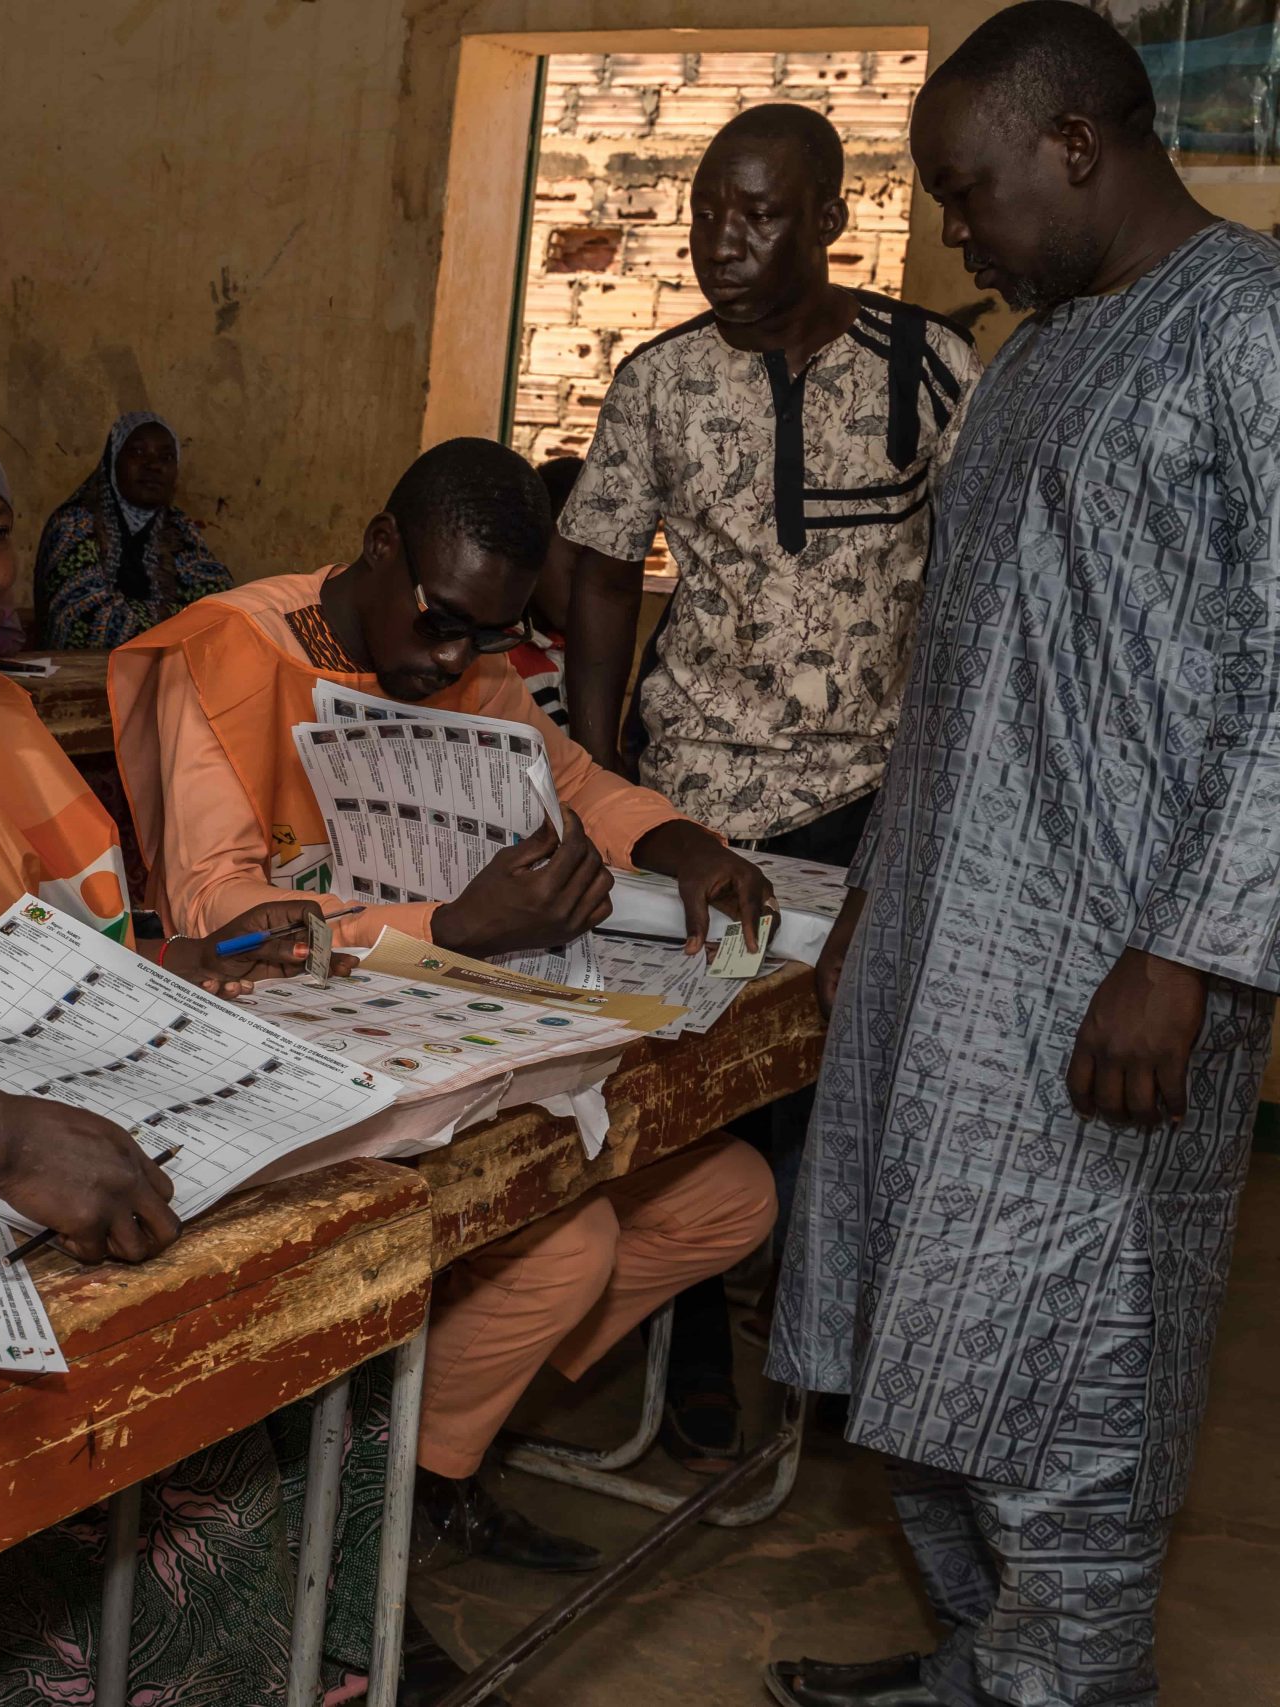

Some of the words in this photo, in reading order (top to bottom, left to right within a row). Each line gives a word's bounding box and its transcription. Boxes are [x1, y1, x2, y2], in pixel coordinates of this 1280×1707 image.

[55, 930, 68, 939] ECOLE
[68, 938, 80, 947] SAHEL
[66, 930, 80, 940] NIAMEY
[584, 974, 590, 983] DU
[136, 962, 164, 979] ÉLECTIONS
[169, 980, 191, 994] CONSEIL
[190, 991, 239, 1018] D'ARRONDISSEMENT
[252, 1022, 281, 1039] DÉCEMBRE
[292, 1043, 308, 1052] LISTE
[307, 1048, 348, 1069] D'ÉMARGEMENT
[352, 1076, 375, 1089] CENI
